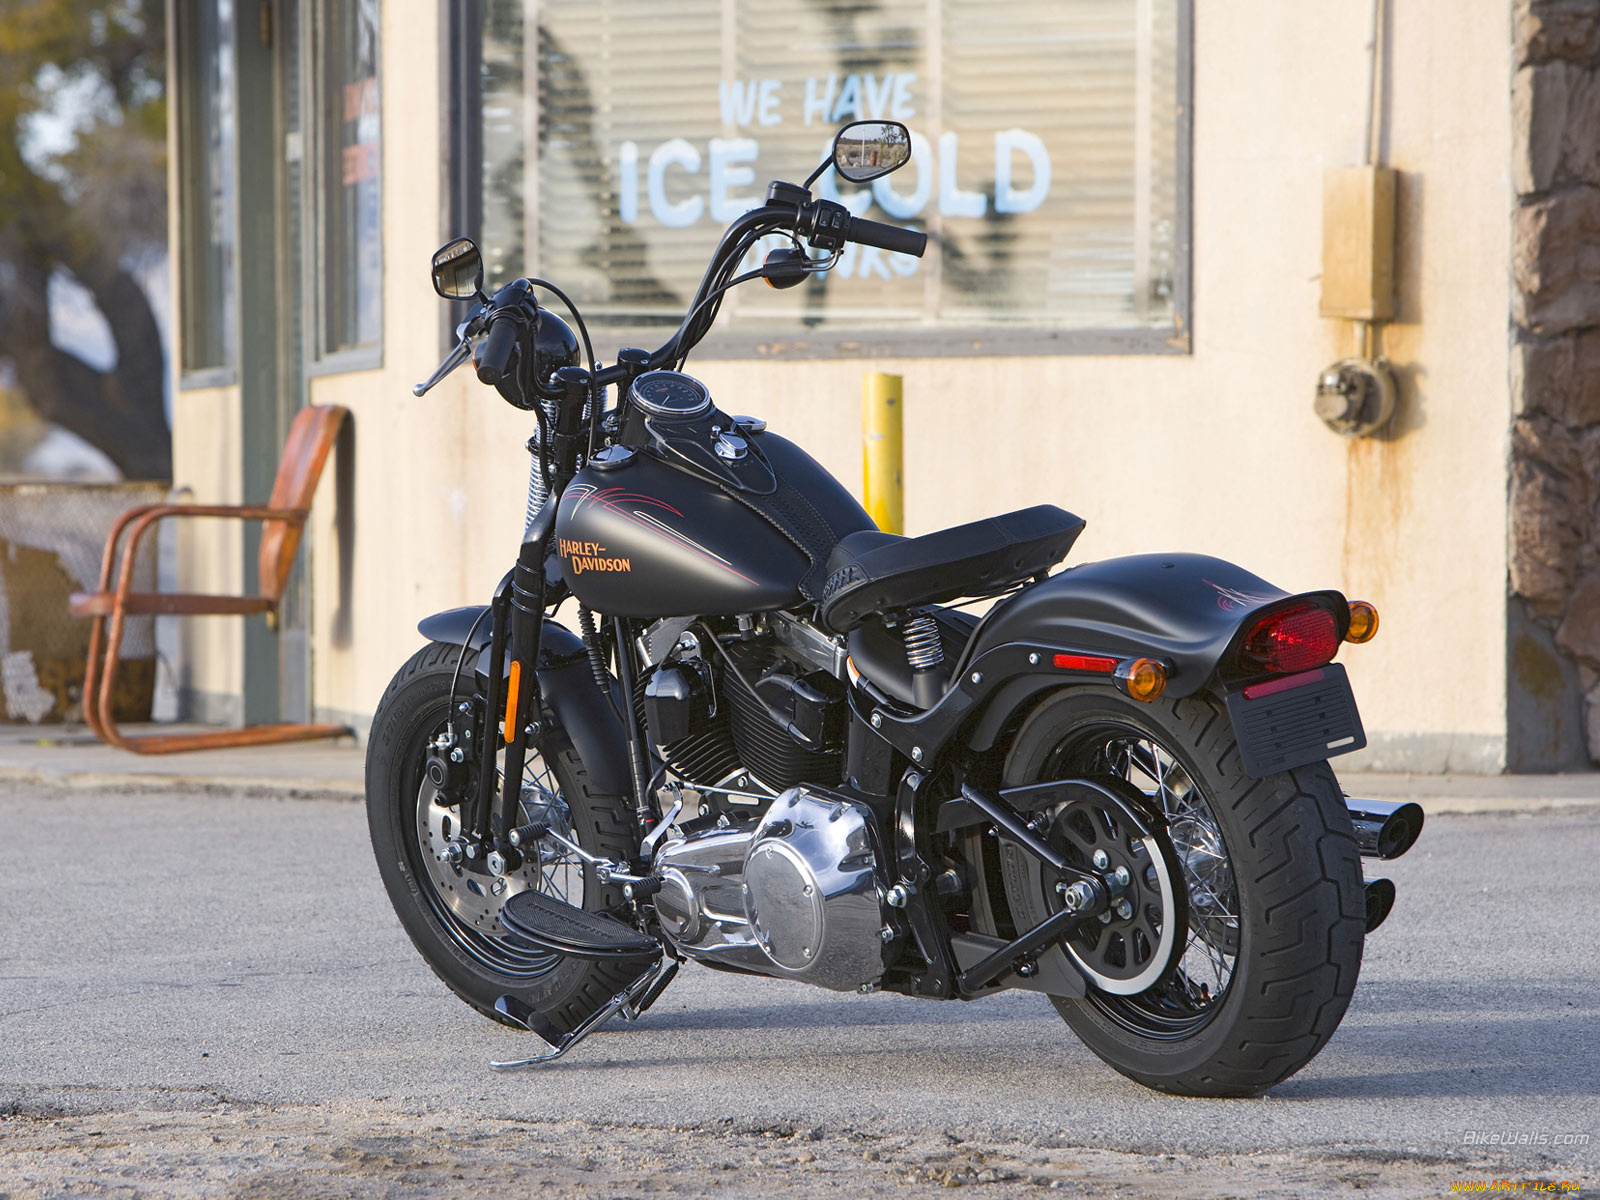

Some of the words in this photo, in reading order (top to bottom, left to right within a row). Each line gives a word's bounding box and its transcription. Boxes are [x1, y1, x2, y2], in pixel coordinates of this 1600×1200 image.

[718, 78, 783, 127] WE
[803, 71, 917, 127] HAVE
[618, 137, 764, 228] ICE
[818, 127, 1052, 219] COLD
[572, 556, 631, 575] DAVIDSON
